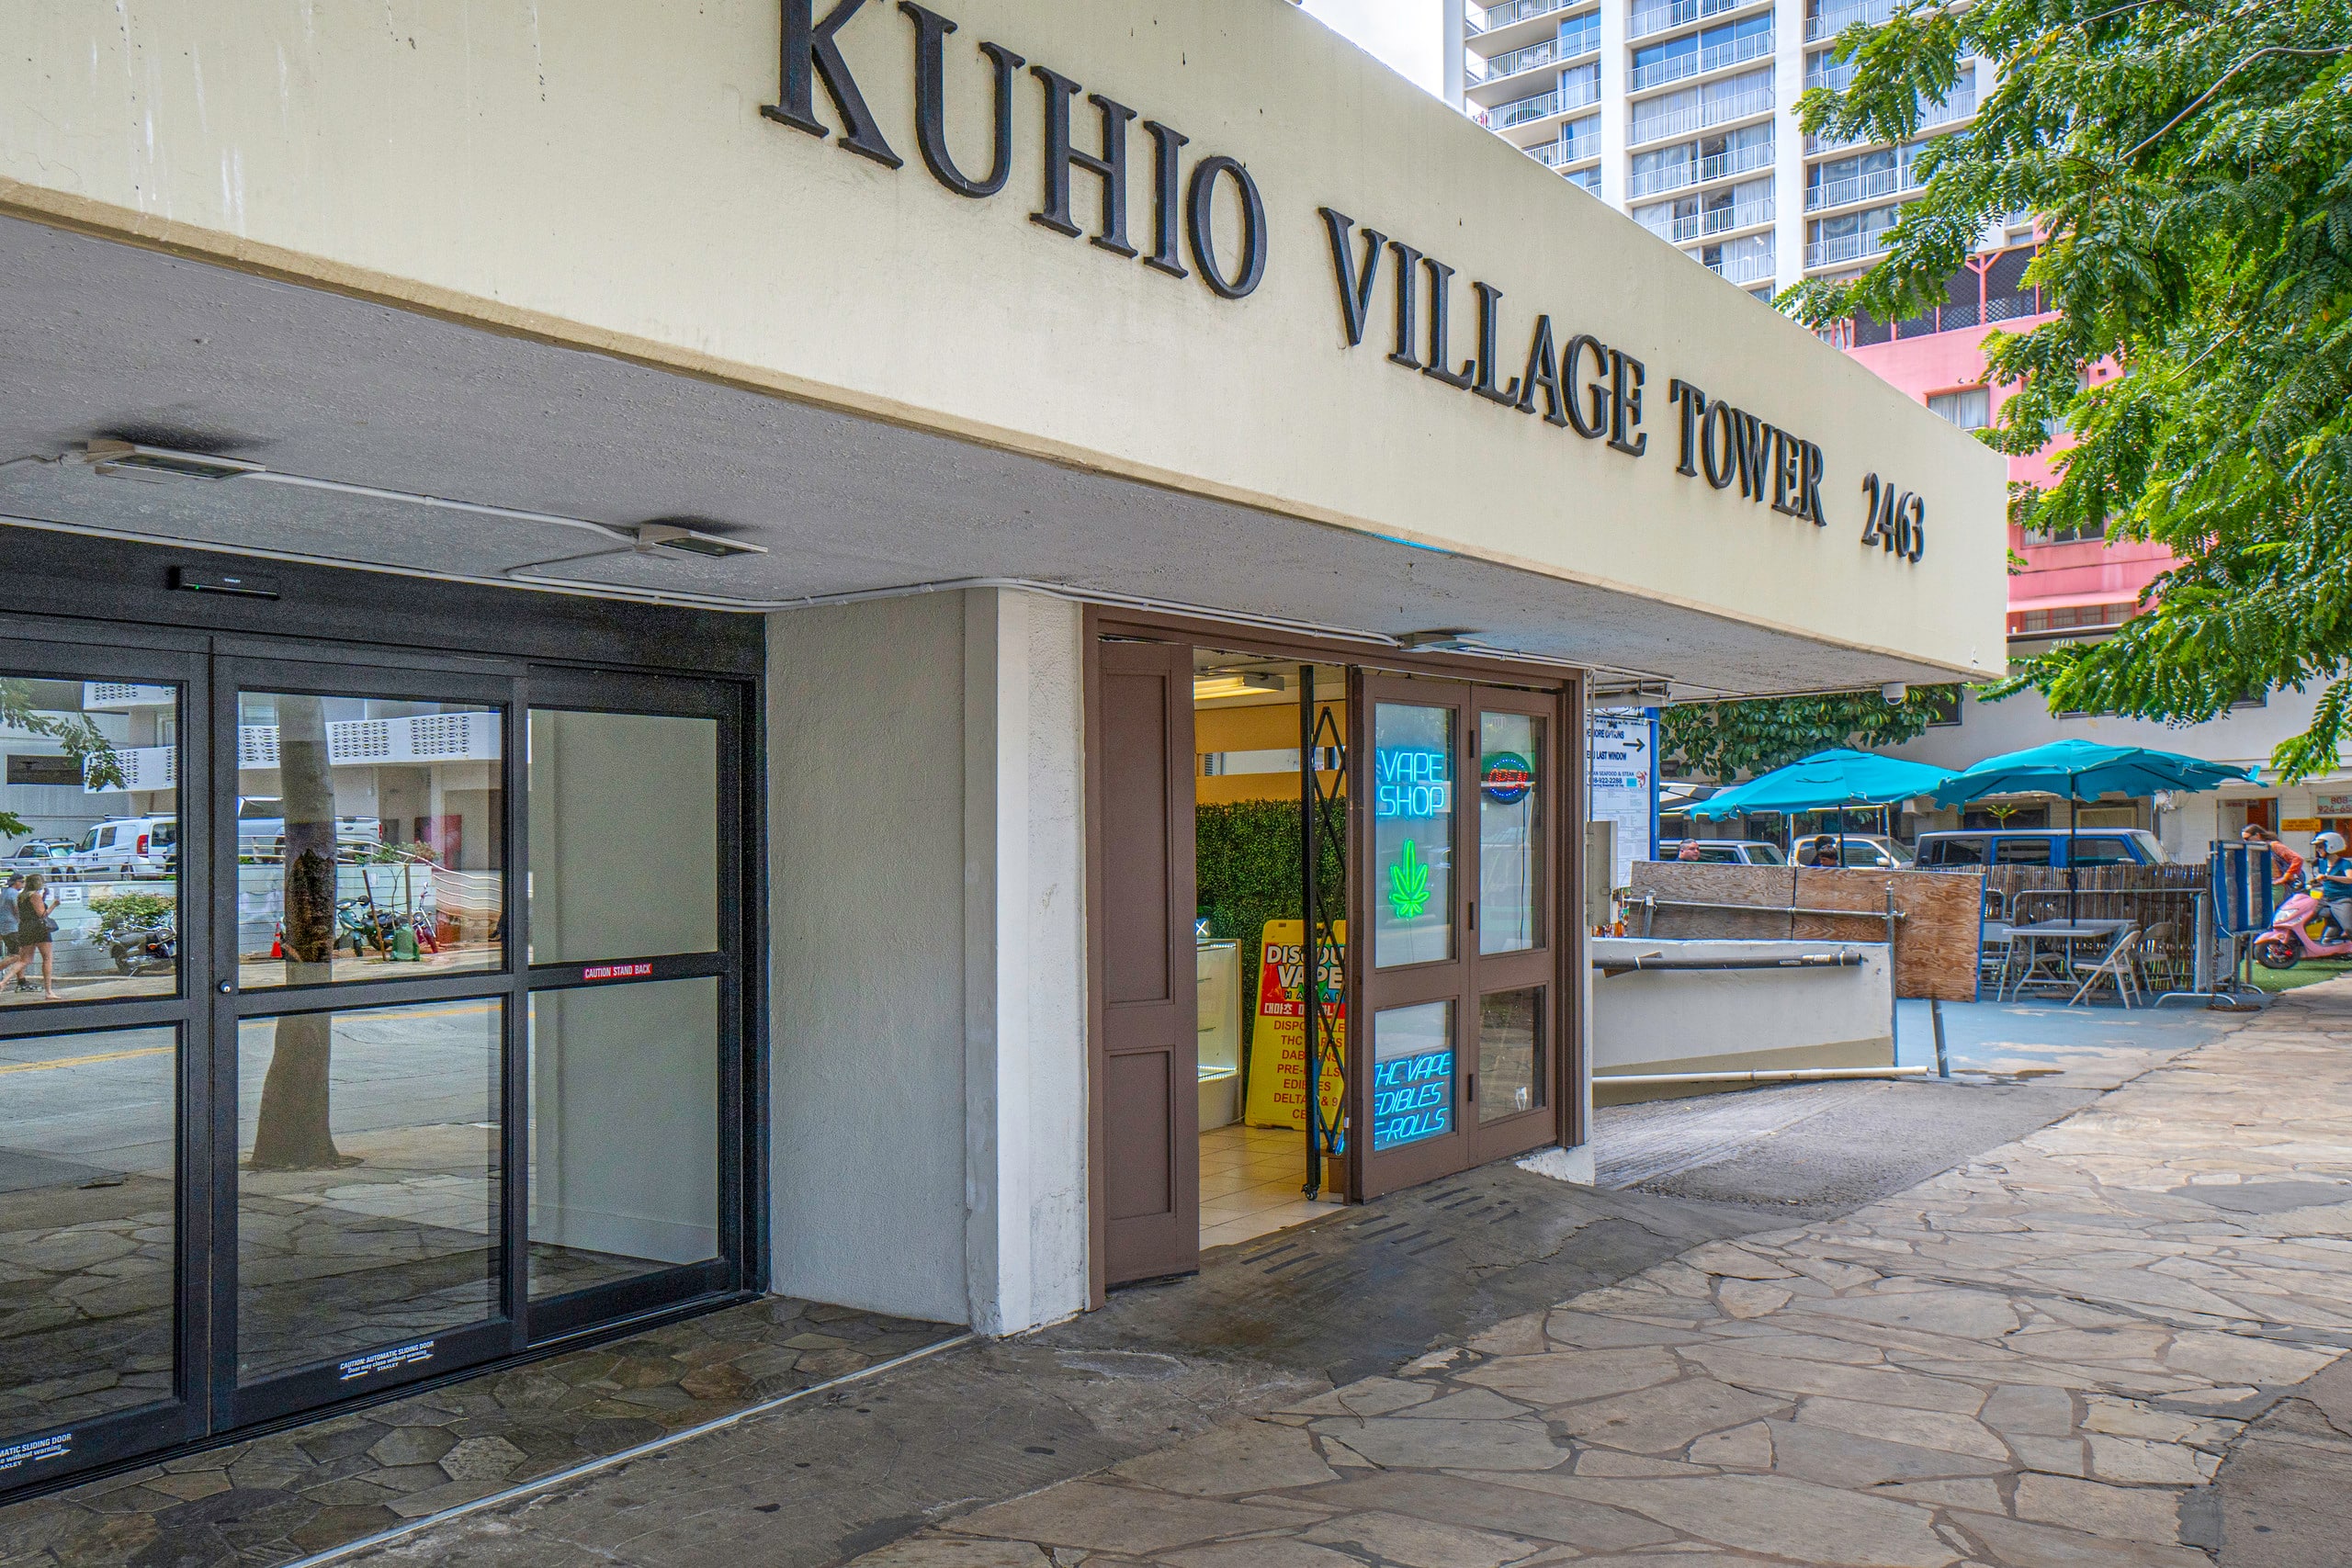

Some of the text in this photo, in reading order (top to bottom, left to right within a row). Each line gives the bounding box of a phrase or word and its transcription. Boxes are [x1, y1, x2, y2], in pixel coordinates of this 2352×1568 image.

[761, 0, 1925, 563] KUHIO VILLAGE TOWER 2463
[1597, 750, 1607, 760] LAST
[1609, 751, 1627, 761] WINDOW
[1381, 750, 1444, 783] VAPE
[1488, 768, 1528, 789] OPEN
[1379, 785, 1444, 816] SHOP
[584, 963, 650, 978] CAUTION STAND BACK
[1264, 1002, 1294, 1015] 대마초
[1281, 1034, 1303, 1045] THC
[1408, 1052, 1451, 1082] VAPE
[1321, 1097, 1329, 1106] &
[347, 1365, 360, 1373] Door
[372, 1359, 387, 1368] close
[387, 1353, 406, 1364] without
[406, 1349, 427, 1359] warning
[366, 1348, 398, 1363] AUTOMATIC
[397, 1344, 419, 1355] SLIDING
[419, 1340, 435, 1350] DOOR
[377, 1361, 399, 1372] STANLEY
[22, 1438, 51, 1452] SLIDING
[51, 1433, 72, 1445] DOOR
[6, 1450, 33, 1463] without
[33, 1443, 62, 1456] warning
